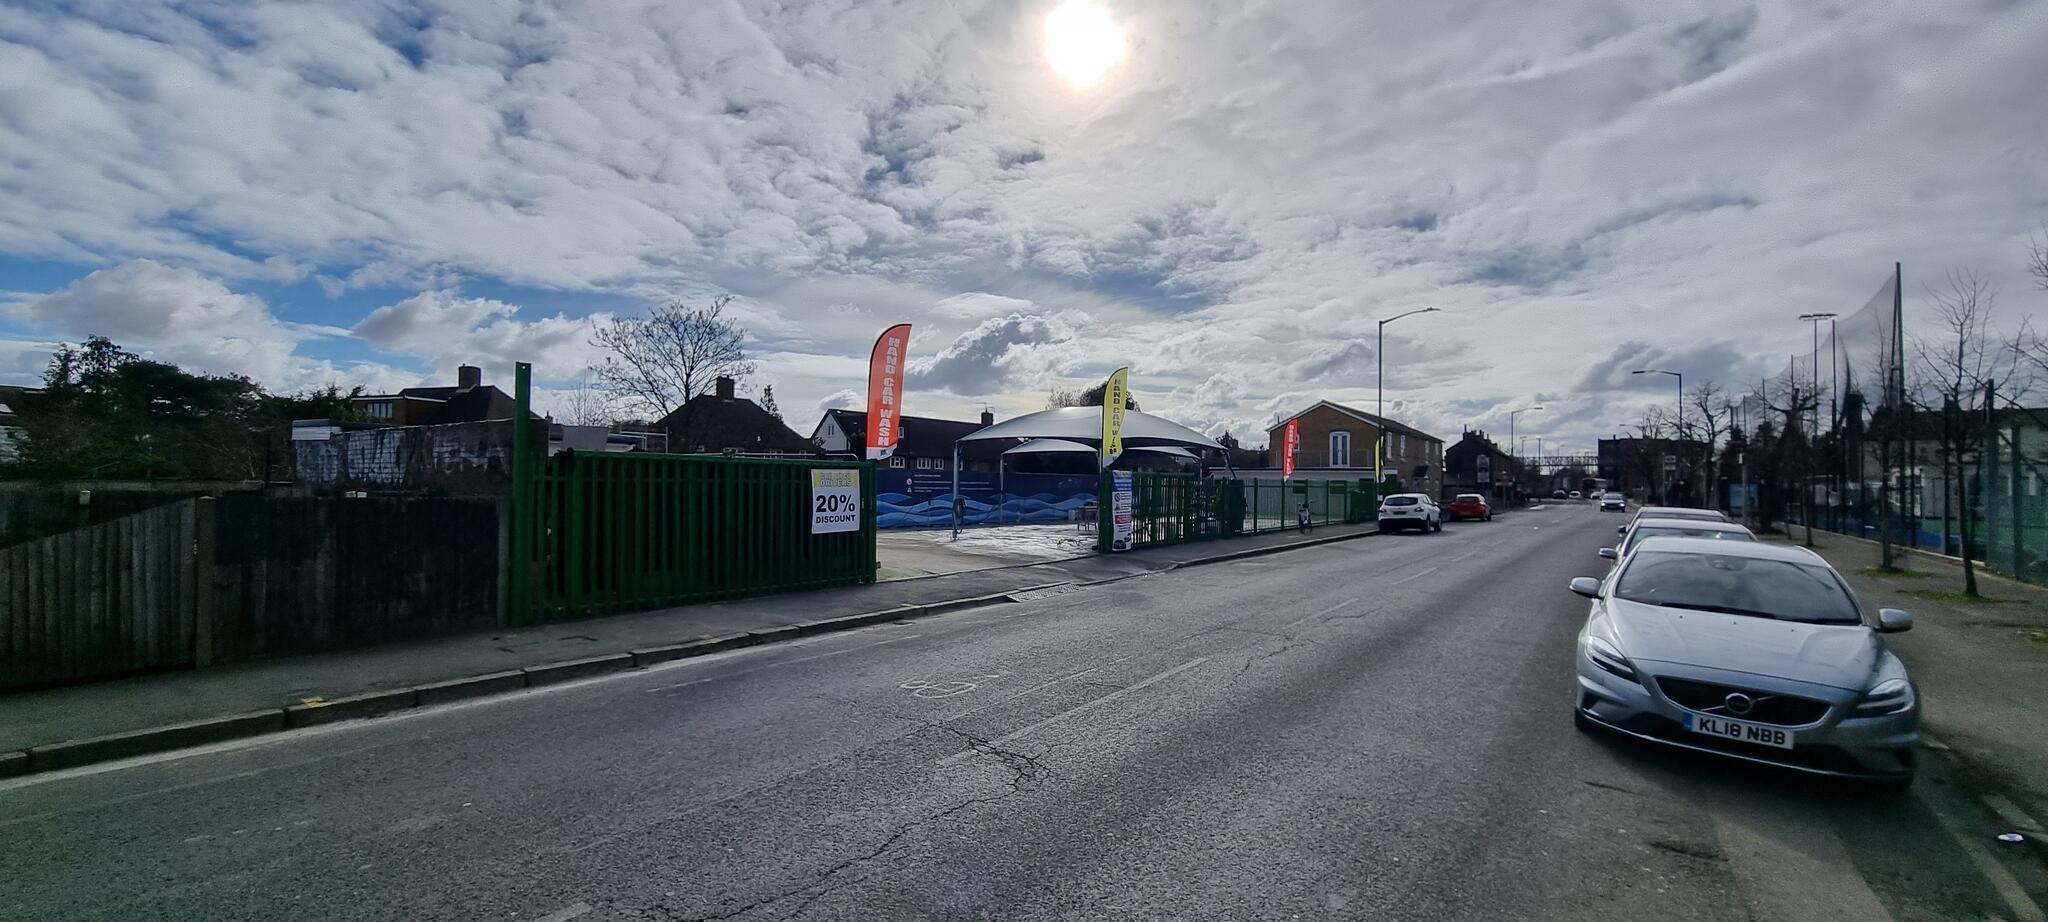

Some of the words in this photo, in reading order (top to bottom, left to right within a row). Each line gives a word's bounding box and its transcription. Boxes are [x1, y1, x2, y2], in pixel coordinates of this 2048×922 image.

[884, 337, 900, 374] HAND
[882, 377, 895, 405] CAR
[877, 408, 893, 446] WASH
[1112, 407, 1120, 427] CAR
[815, 494, 856, 513] 20%
[815, 514, 856, 524] DISCOUNT
[1699, 718, 1742, 737] KL18
[1746, 726, 1786, 745] NBB
